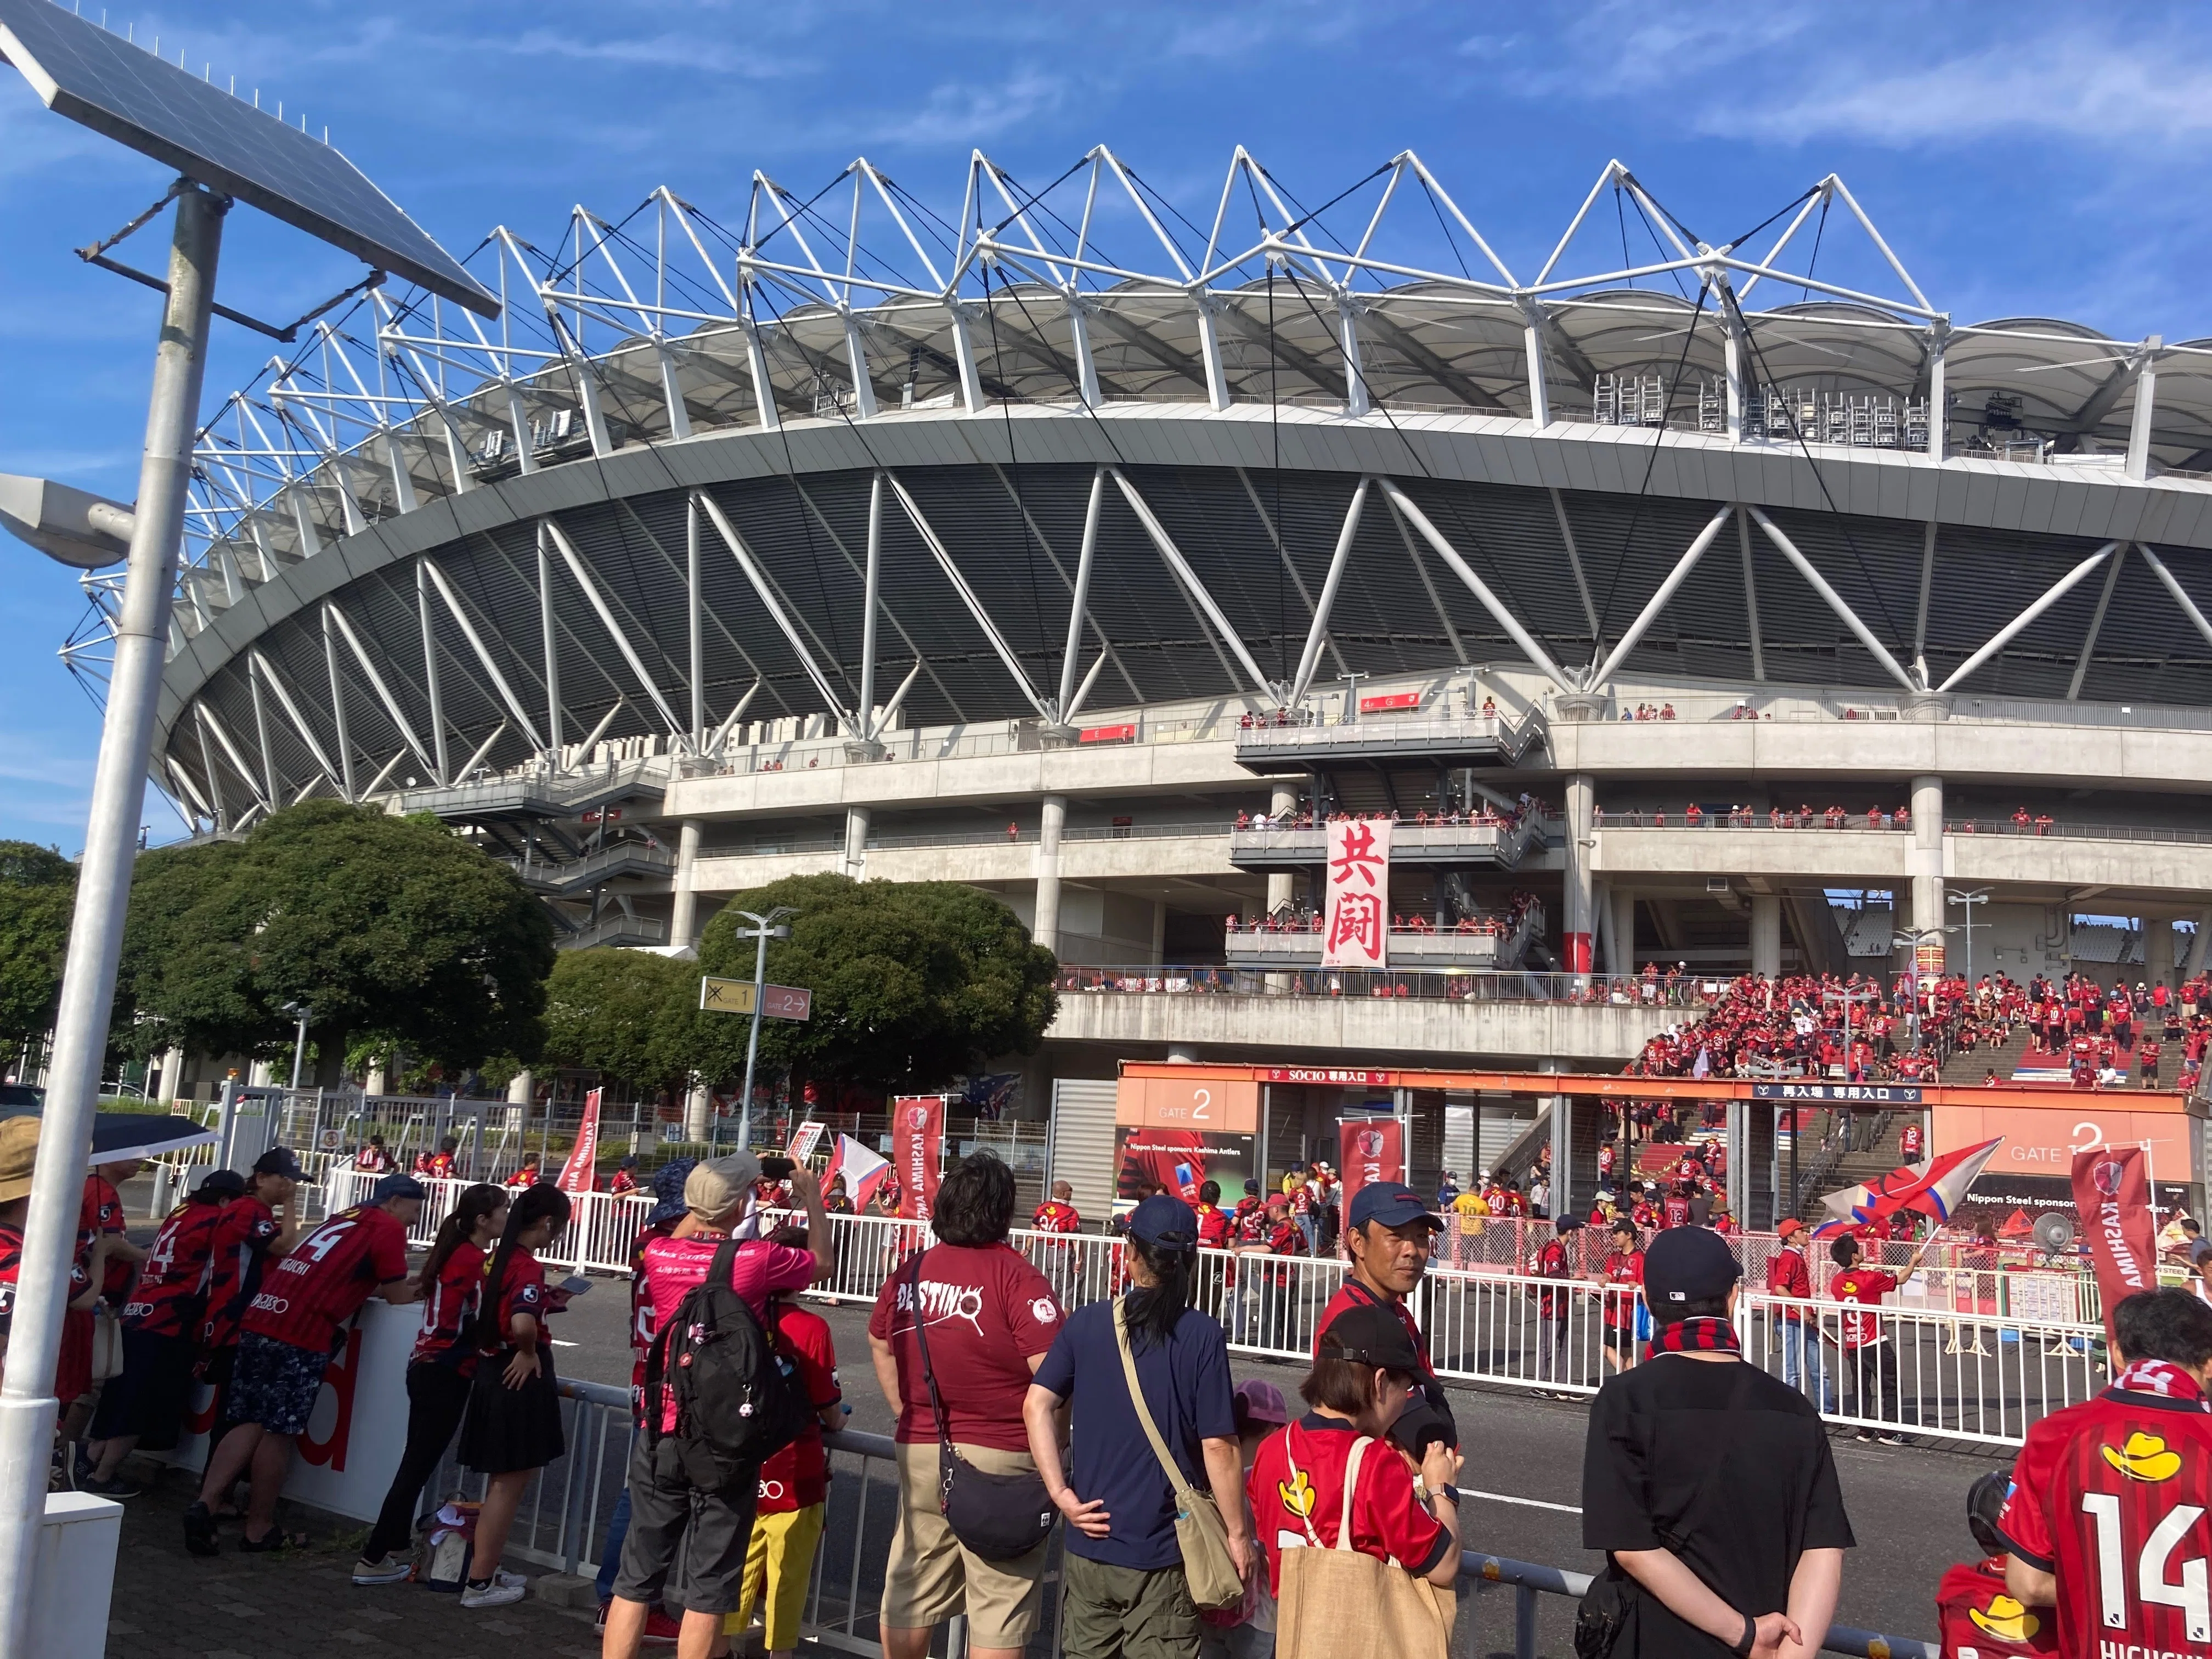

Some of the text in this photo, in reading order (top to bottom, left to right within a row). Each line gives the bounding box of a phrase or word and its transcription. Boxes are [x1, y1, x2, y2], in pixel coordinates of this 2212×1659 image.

[1385, 698, 1393, 706] G
[742, 989, 748, 1006] 1
[783, 995, 793, 1011] 2
[1329, 1071, 1367, 1082] 専用入口
[1783, 1086, 1889, 1099] 再入場 専用入口
[1159, 1088, 1211, 1119] GATE 2
[1907, 1130, 1917, 1142] 12
[2011, 1122, 2103, 1163] GATE 2
[1167, 1145, 1192, 1153] sponsors
[1194, 1146, 1218, 1154] Kashima
[1488, 1194, 1504, 1211] 40
[1967, 1193, 2004, 1204] Nippon
[2006, 1195, 2032, 1205] Steel
[1669, 1209, 1683, 1223] 12
[2164, 1267, 2186, 1276] STEEL
[2081, 1492, 2211, 1643] 14
